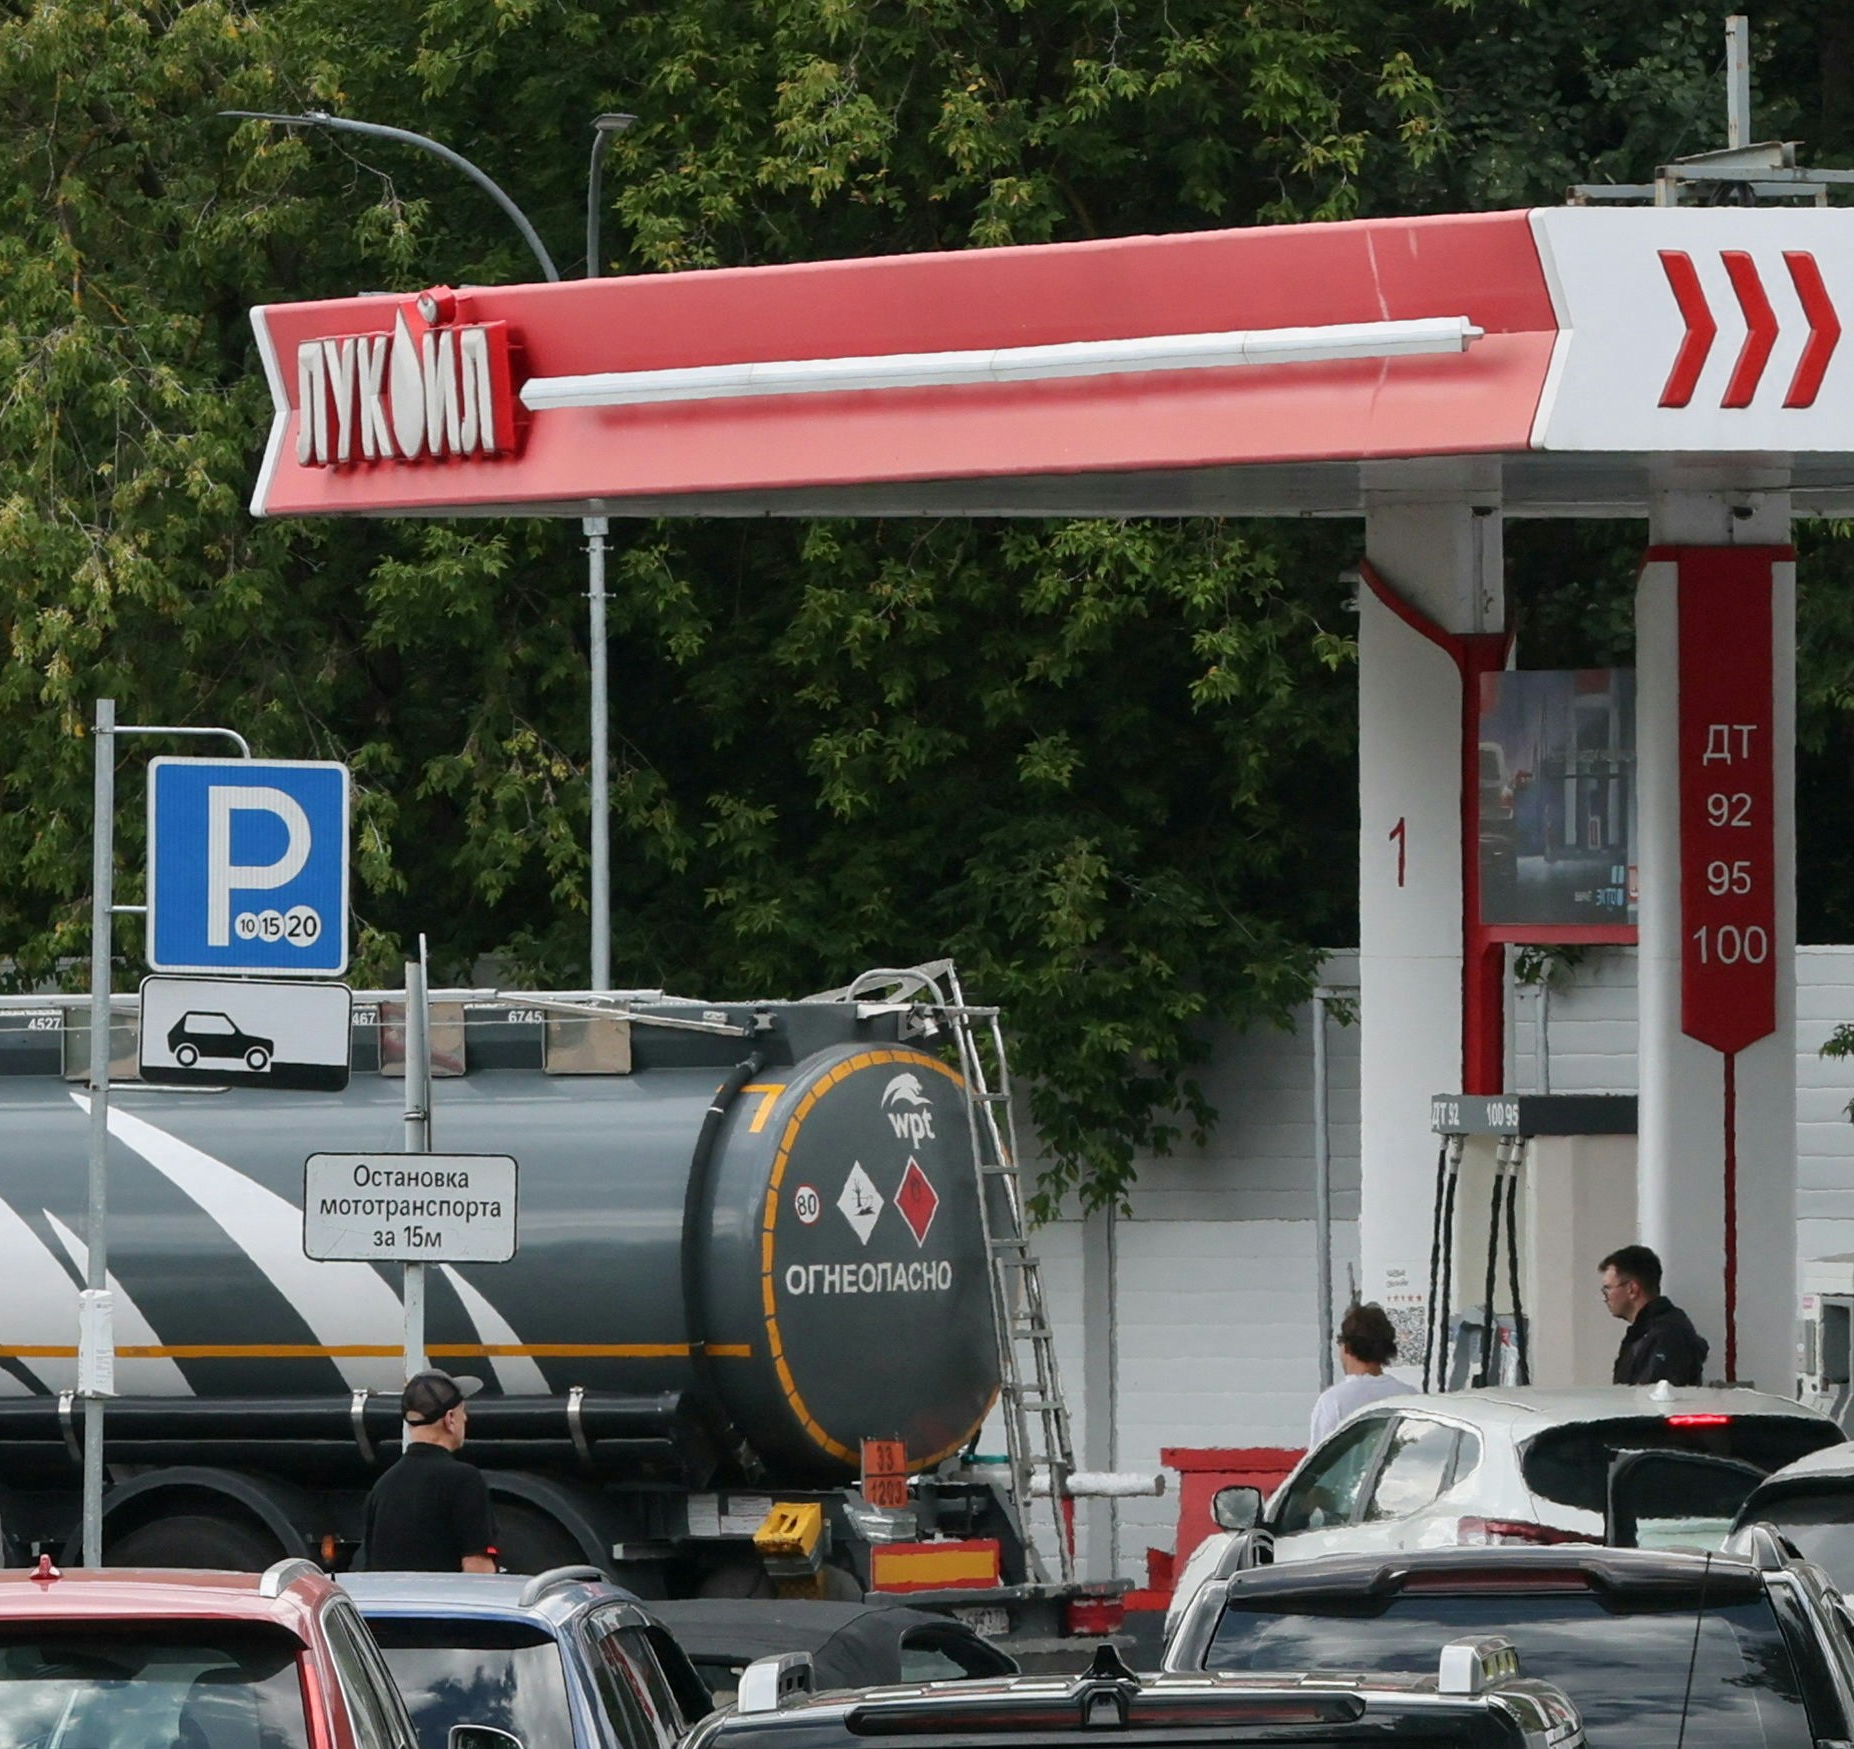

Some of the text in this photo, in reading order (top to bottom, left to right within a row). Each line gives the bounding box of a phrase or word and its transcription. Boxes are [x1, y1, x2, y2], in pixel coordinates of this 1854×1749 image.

[298, 293, 495, 465] ЛУКОЙЛ
[1703, 724, 1758, 766] ДТ
[1707, 792, 1752, 828] 92
[208, 785, 312, 947] P
[1388, 816, 1406, 888] 1
[1707, 861, 1752, 896] 95
[240, 915, 317, 938] 10 15 20
[1693, 925, 1768, 965] 100
[27, 1016, 61, 1030] 4527
[507, 1010, 543, 1025] 6745
[888, 1108, 936, 1150] wpt
[1432, 1101, 1519, 1129] ДТ 92 100 95
[353, 1164, 470, 1189] Остановка
[320, 1198, 502, 1224] мототранспорта
[797, 1193, 817, 1216] 80
[373, 1225, 442, 1248] за 15м
[785, 1260, 952, 1295] ОГНЕОПАСНО
[876, 1444, 895, 1472] 33
